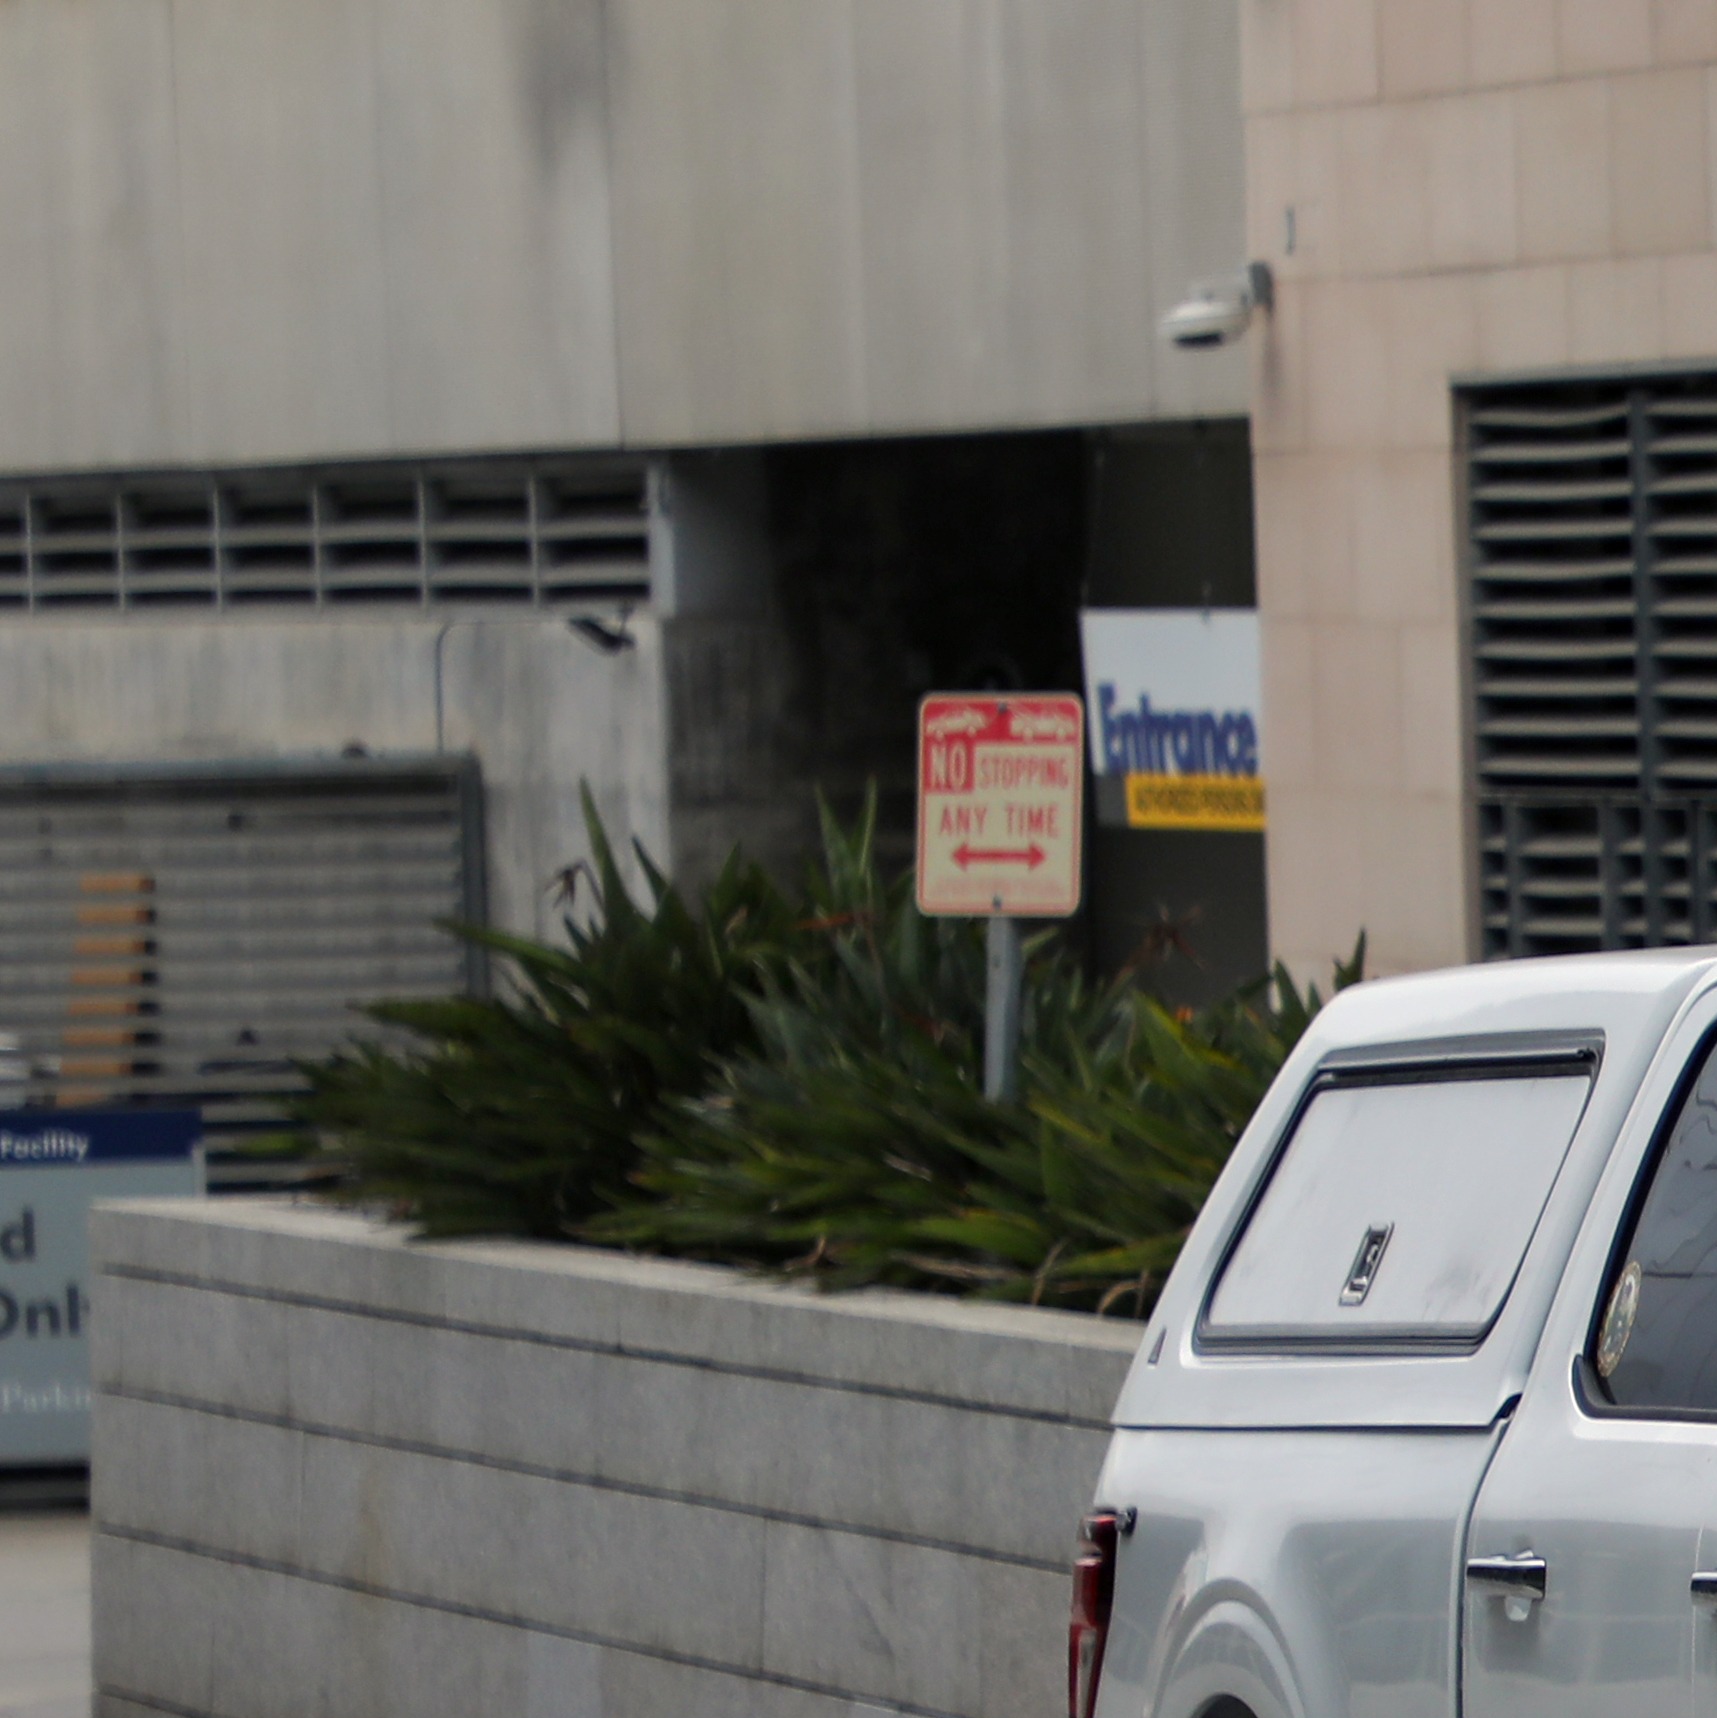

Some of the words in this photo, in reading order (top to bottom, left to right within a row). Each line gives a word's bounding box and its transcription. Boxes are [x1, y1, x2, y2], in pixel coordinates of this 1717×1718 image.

[929, 741, 967, 791] NO
[977, 755, 1069, 790] STOPPING
[940, 804, 989, 837] ANY
[1005, 803, 1060, 839] TIME
